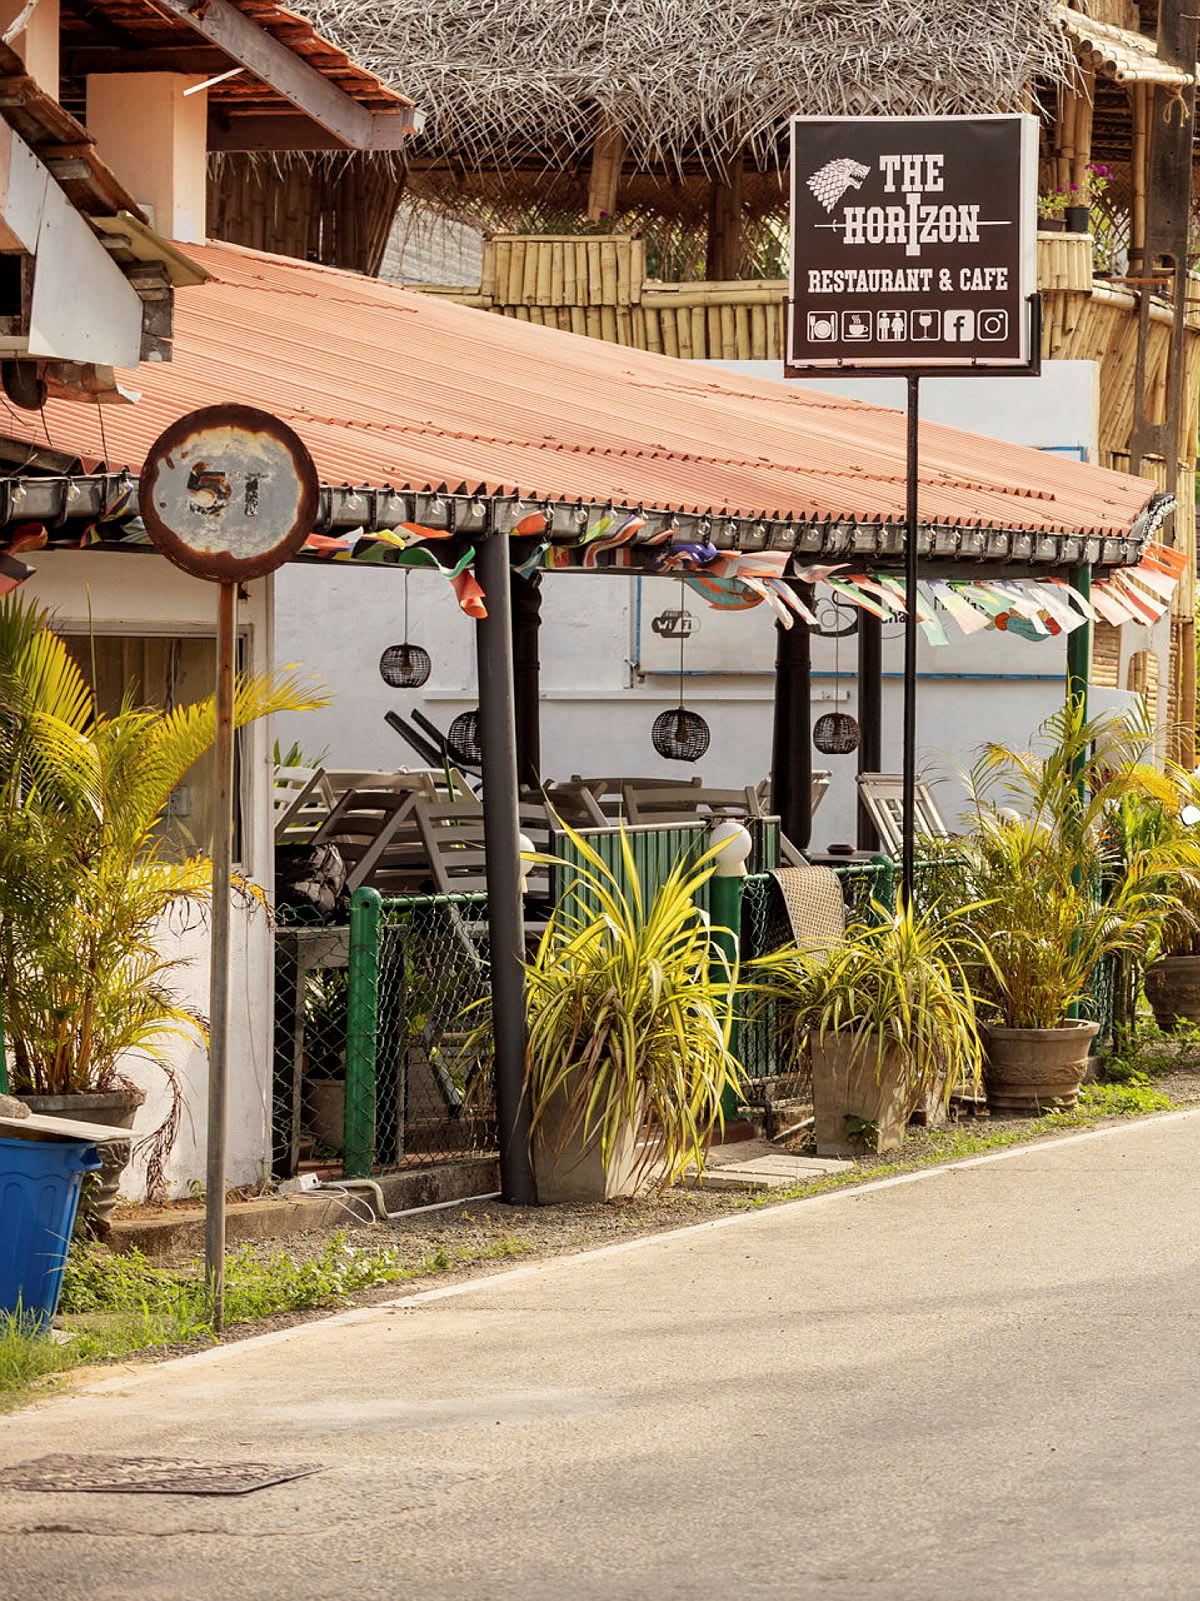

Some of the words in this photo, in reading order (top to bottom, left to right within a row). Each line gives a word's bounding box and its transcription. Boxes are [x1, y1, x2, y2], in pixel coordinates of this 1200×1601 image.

[879, 154, 944, 192] THE
[843, 193, 980, 256] HORIZON
[807, 269, 933, 294] RESTAURANT
[939, 269, 954, 291] &
[959, 267, 1008, 291] CAFE
